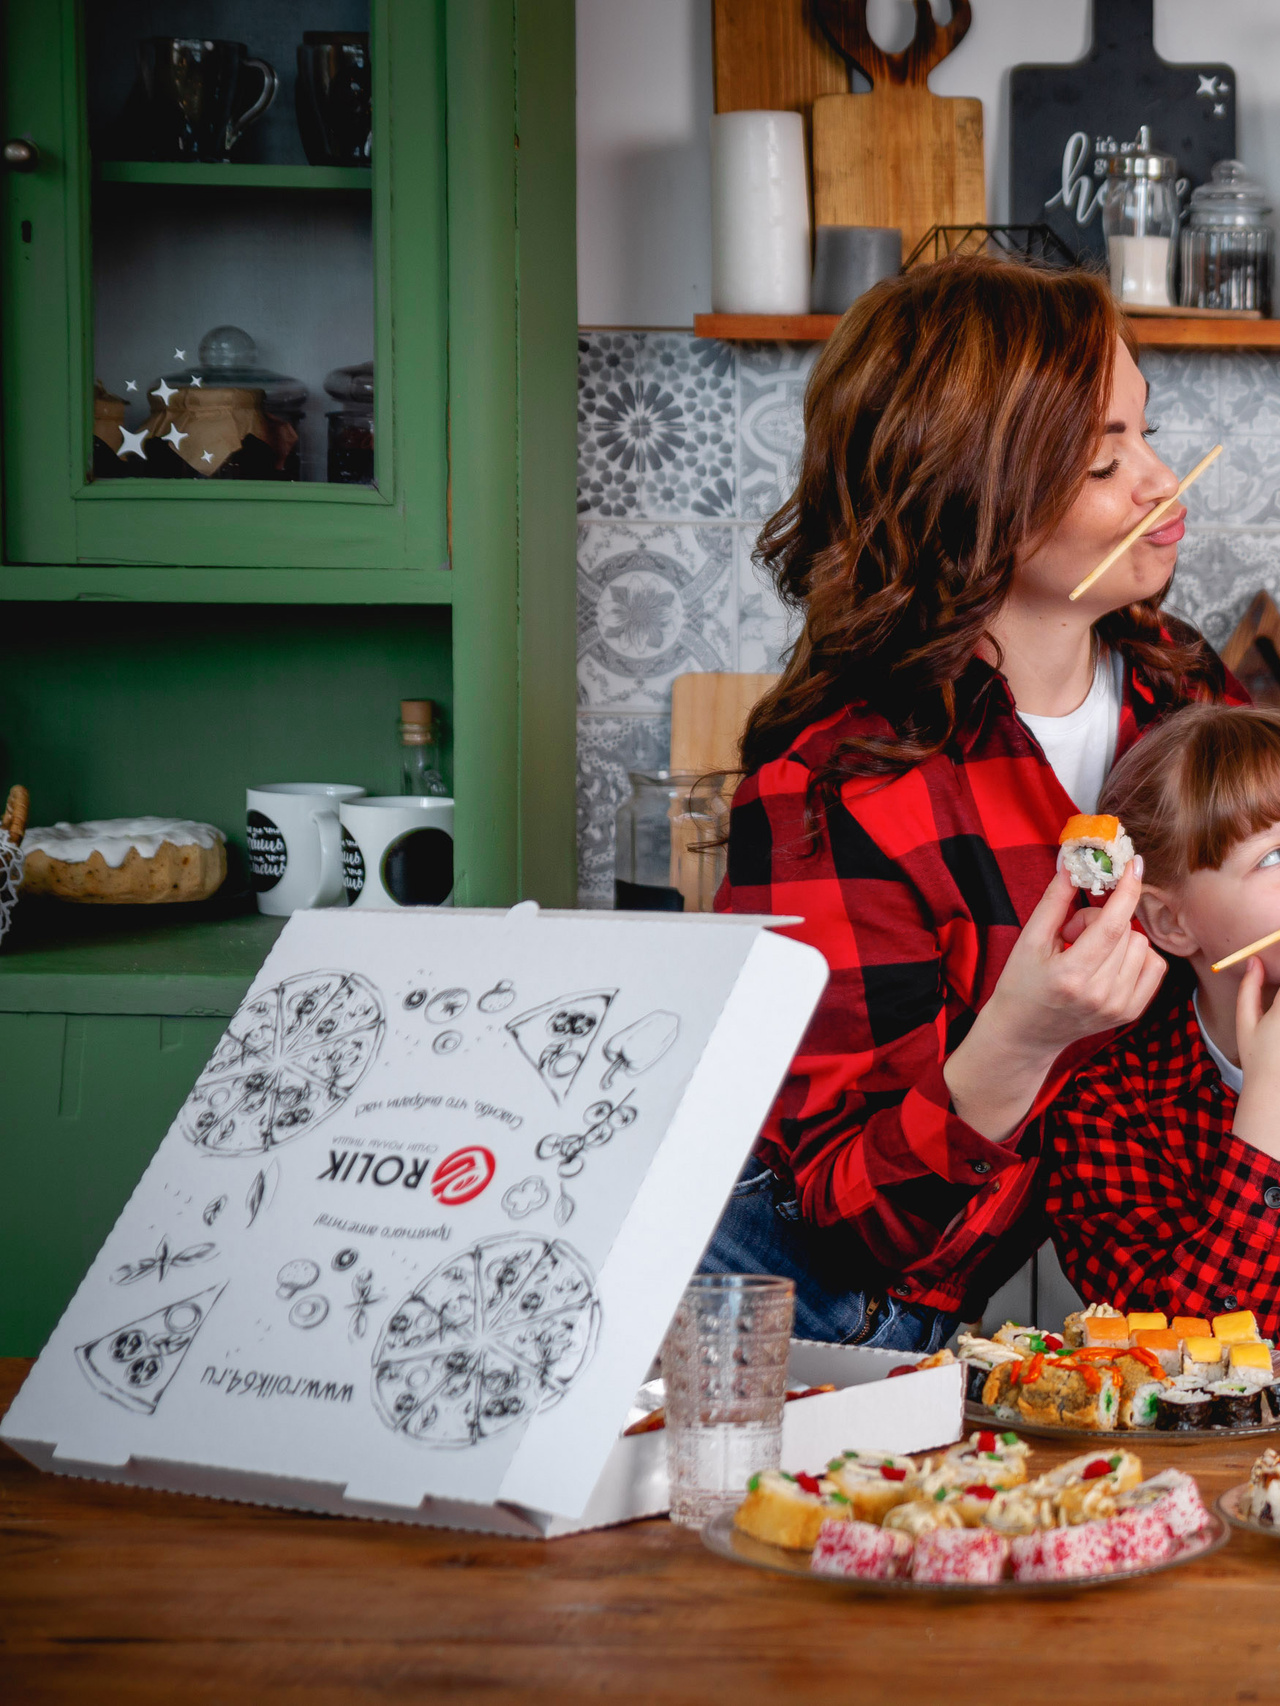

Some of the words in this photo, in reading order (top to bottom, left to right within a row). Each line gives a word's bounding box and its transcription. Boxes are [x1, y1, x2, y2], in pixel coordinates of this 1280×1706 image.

[1095, 136, 1117, 152] it's
[354, 1102, 383, 1117] нас!
[387, 1093, 443, 1110] выбрали
[446, 1097, 468, 1110] что
[474, 1100, 524, 1130] Спасибо,
[331, 1136, 366, 1147] ПИЦЦА
[369, 1140, 404, 1151] РОЛЛЫ
[407, 1142, 438, 1154] СУШИ
[316, 1150, 430, 1189] ROLIK
[313, 1213, 378, 1235] аппетита!
[380, 1223, 452, 1242] Приятного
[201, 1366, 354, 1403] www.rolik64.ru
